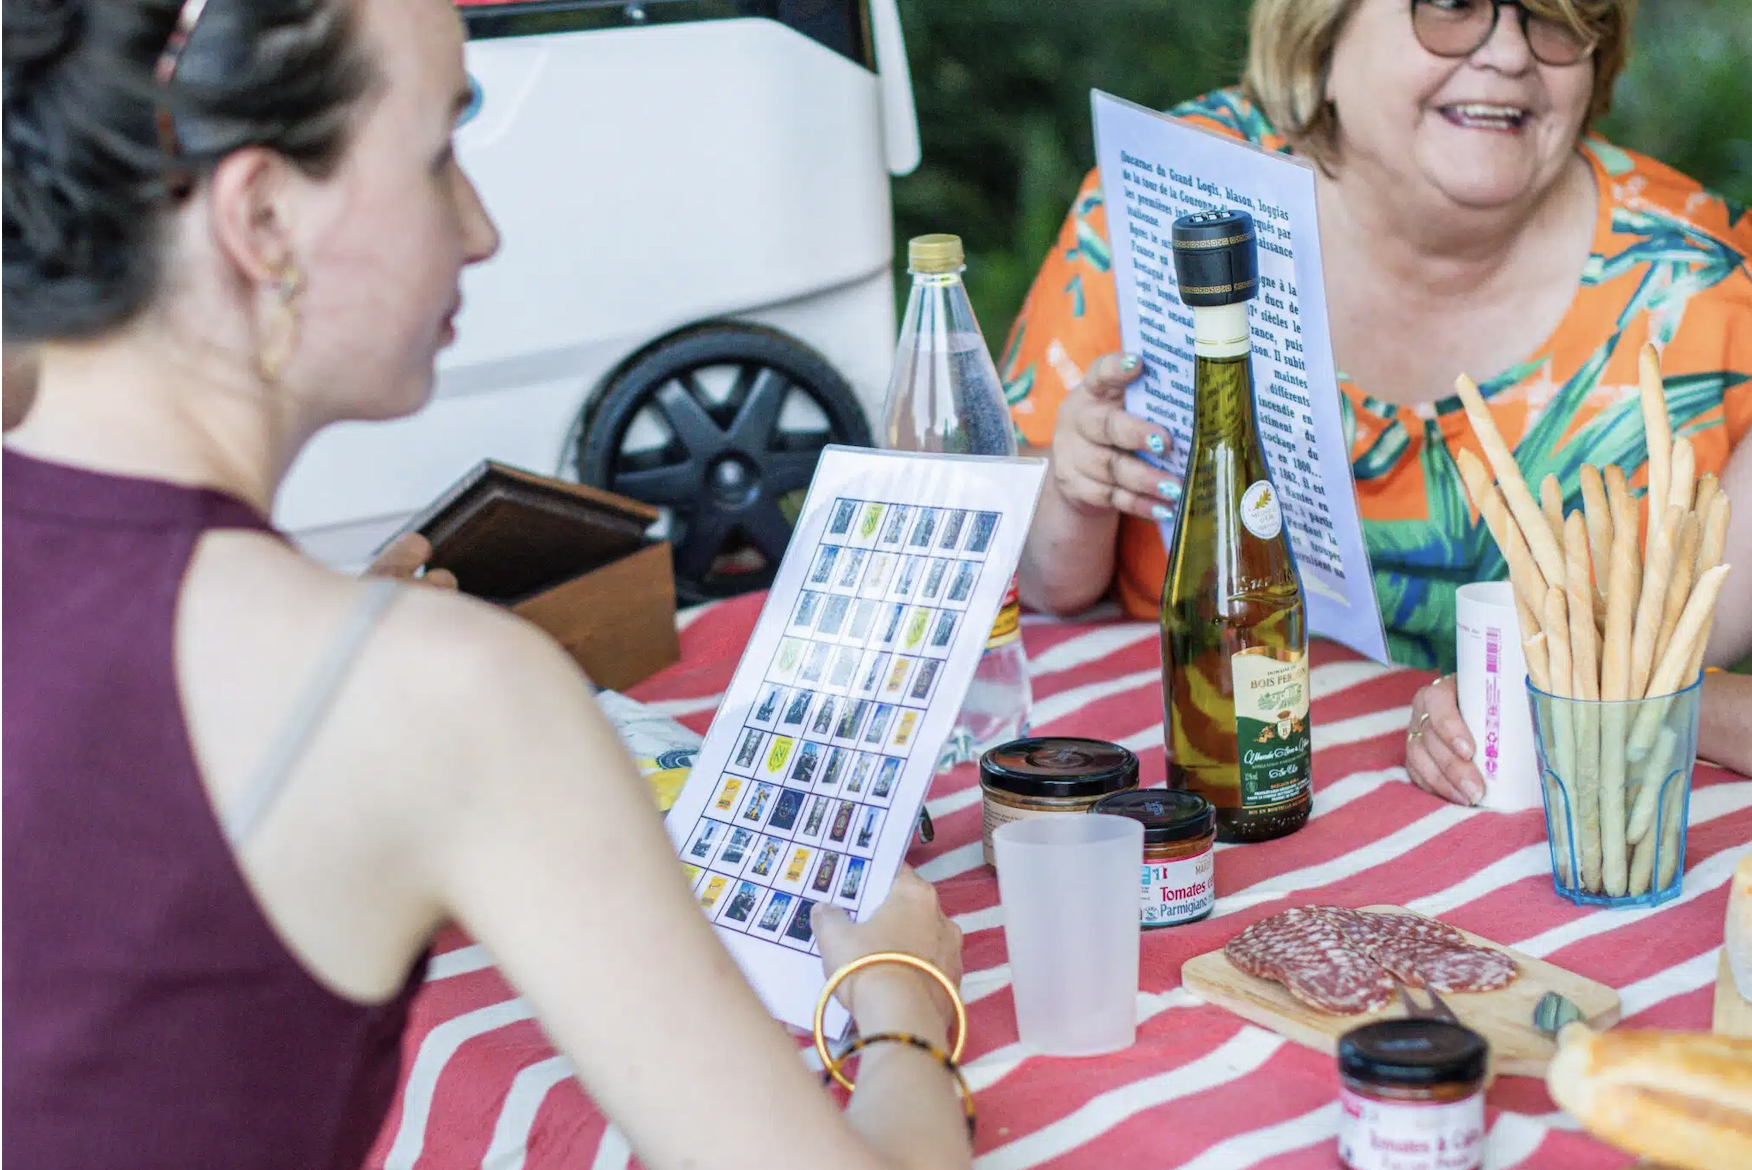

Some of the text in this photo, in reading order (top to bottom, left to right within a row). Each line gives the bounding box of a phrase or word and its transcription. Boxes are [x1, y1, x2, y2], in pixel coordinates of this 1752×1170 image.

[1133, 170, 1141, 185] la
[1160, 183, 1168, 196] de
[1169, 185, 1178, 200] la
[1252, 219, 1275, 234] rqués
[1277, 226, 1292, 240] par
[1169, 168, 1194, 187] Grand
[1196, 177, 1221, 198] Logis,
[1225, 187, 1256, 211] blason,
[1258, 199, 1289, 221] loggias
[1138, 194, 1173, 215] premières
[1257, 237, 1294, 259] aissance
[1260, 276, 1276, 288] gne
[1279, 279, 1286, 292] à
[1288, 282, 1299, 297] la
[1265, 292, 1285, 310] ducs
[1289, 301, 1300, 315] de
[1261, 310, 1289, 330] siècles
[1293, 320, 1303, 334] le
[1250, 340, 1271, 358] ison.
[1274, 349, 1282, 362] Il
[1284, 355, 1306, 371] subit
[1285, 338, 1304, 353] puis
[1274, 369, 1308, 384] maintes
[1270, 382, 1311, 407] différents
[1257, 394, 1295, 418] incendie
[1302, 413, 1314, 426] en
[1305, 428, 1317, 443] du
[1278, 452, 1289, 464] en
[1307, 446, 1319, 461] du
[1313, 484, 1326, 496] est
[1318, 502, 1329, 513] en
[1286, 515, 1323, 540] Pendant
[1327, 532, 1338, 546] la
[1309, 512, 1334, 530] partir
[1250, 677, 1275, 689] BOIS
[1160, 881, 1206, 902] Tomates
[1161, 896, 1208, 918] Parmigiano
